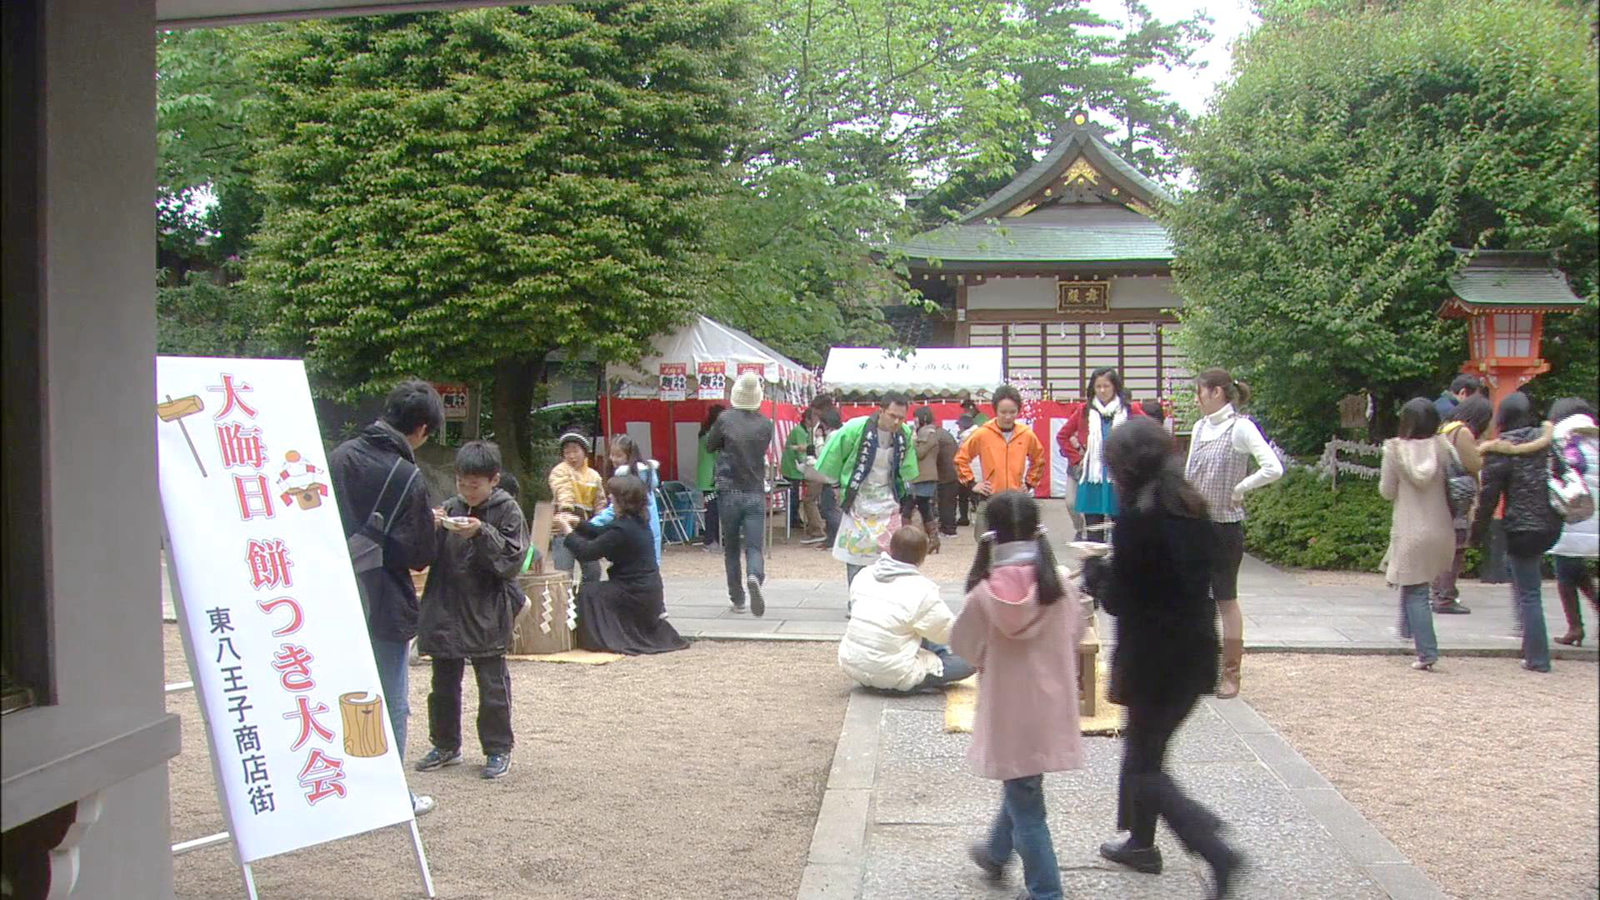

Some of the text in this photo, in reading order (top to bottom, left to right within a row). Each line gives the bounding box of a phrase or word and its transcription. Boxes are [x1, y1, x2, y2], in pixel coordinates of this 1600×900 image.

[206, 373, 349, 806] 大晦日 餅つき大会
[206, 607, 275, 816] 東八王子商店街
